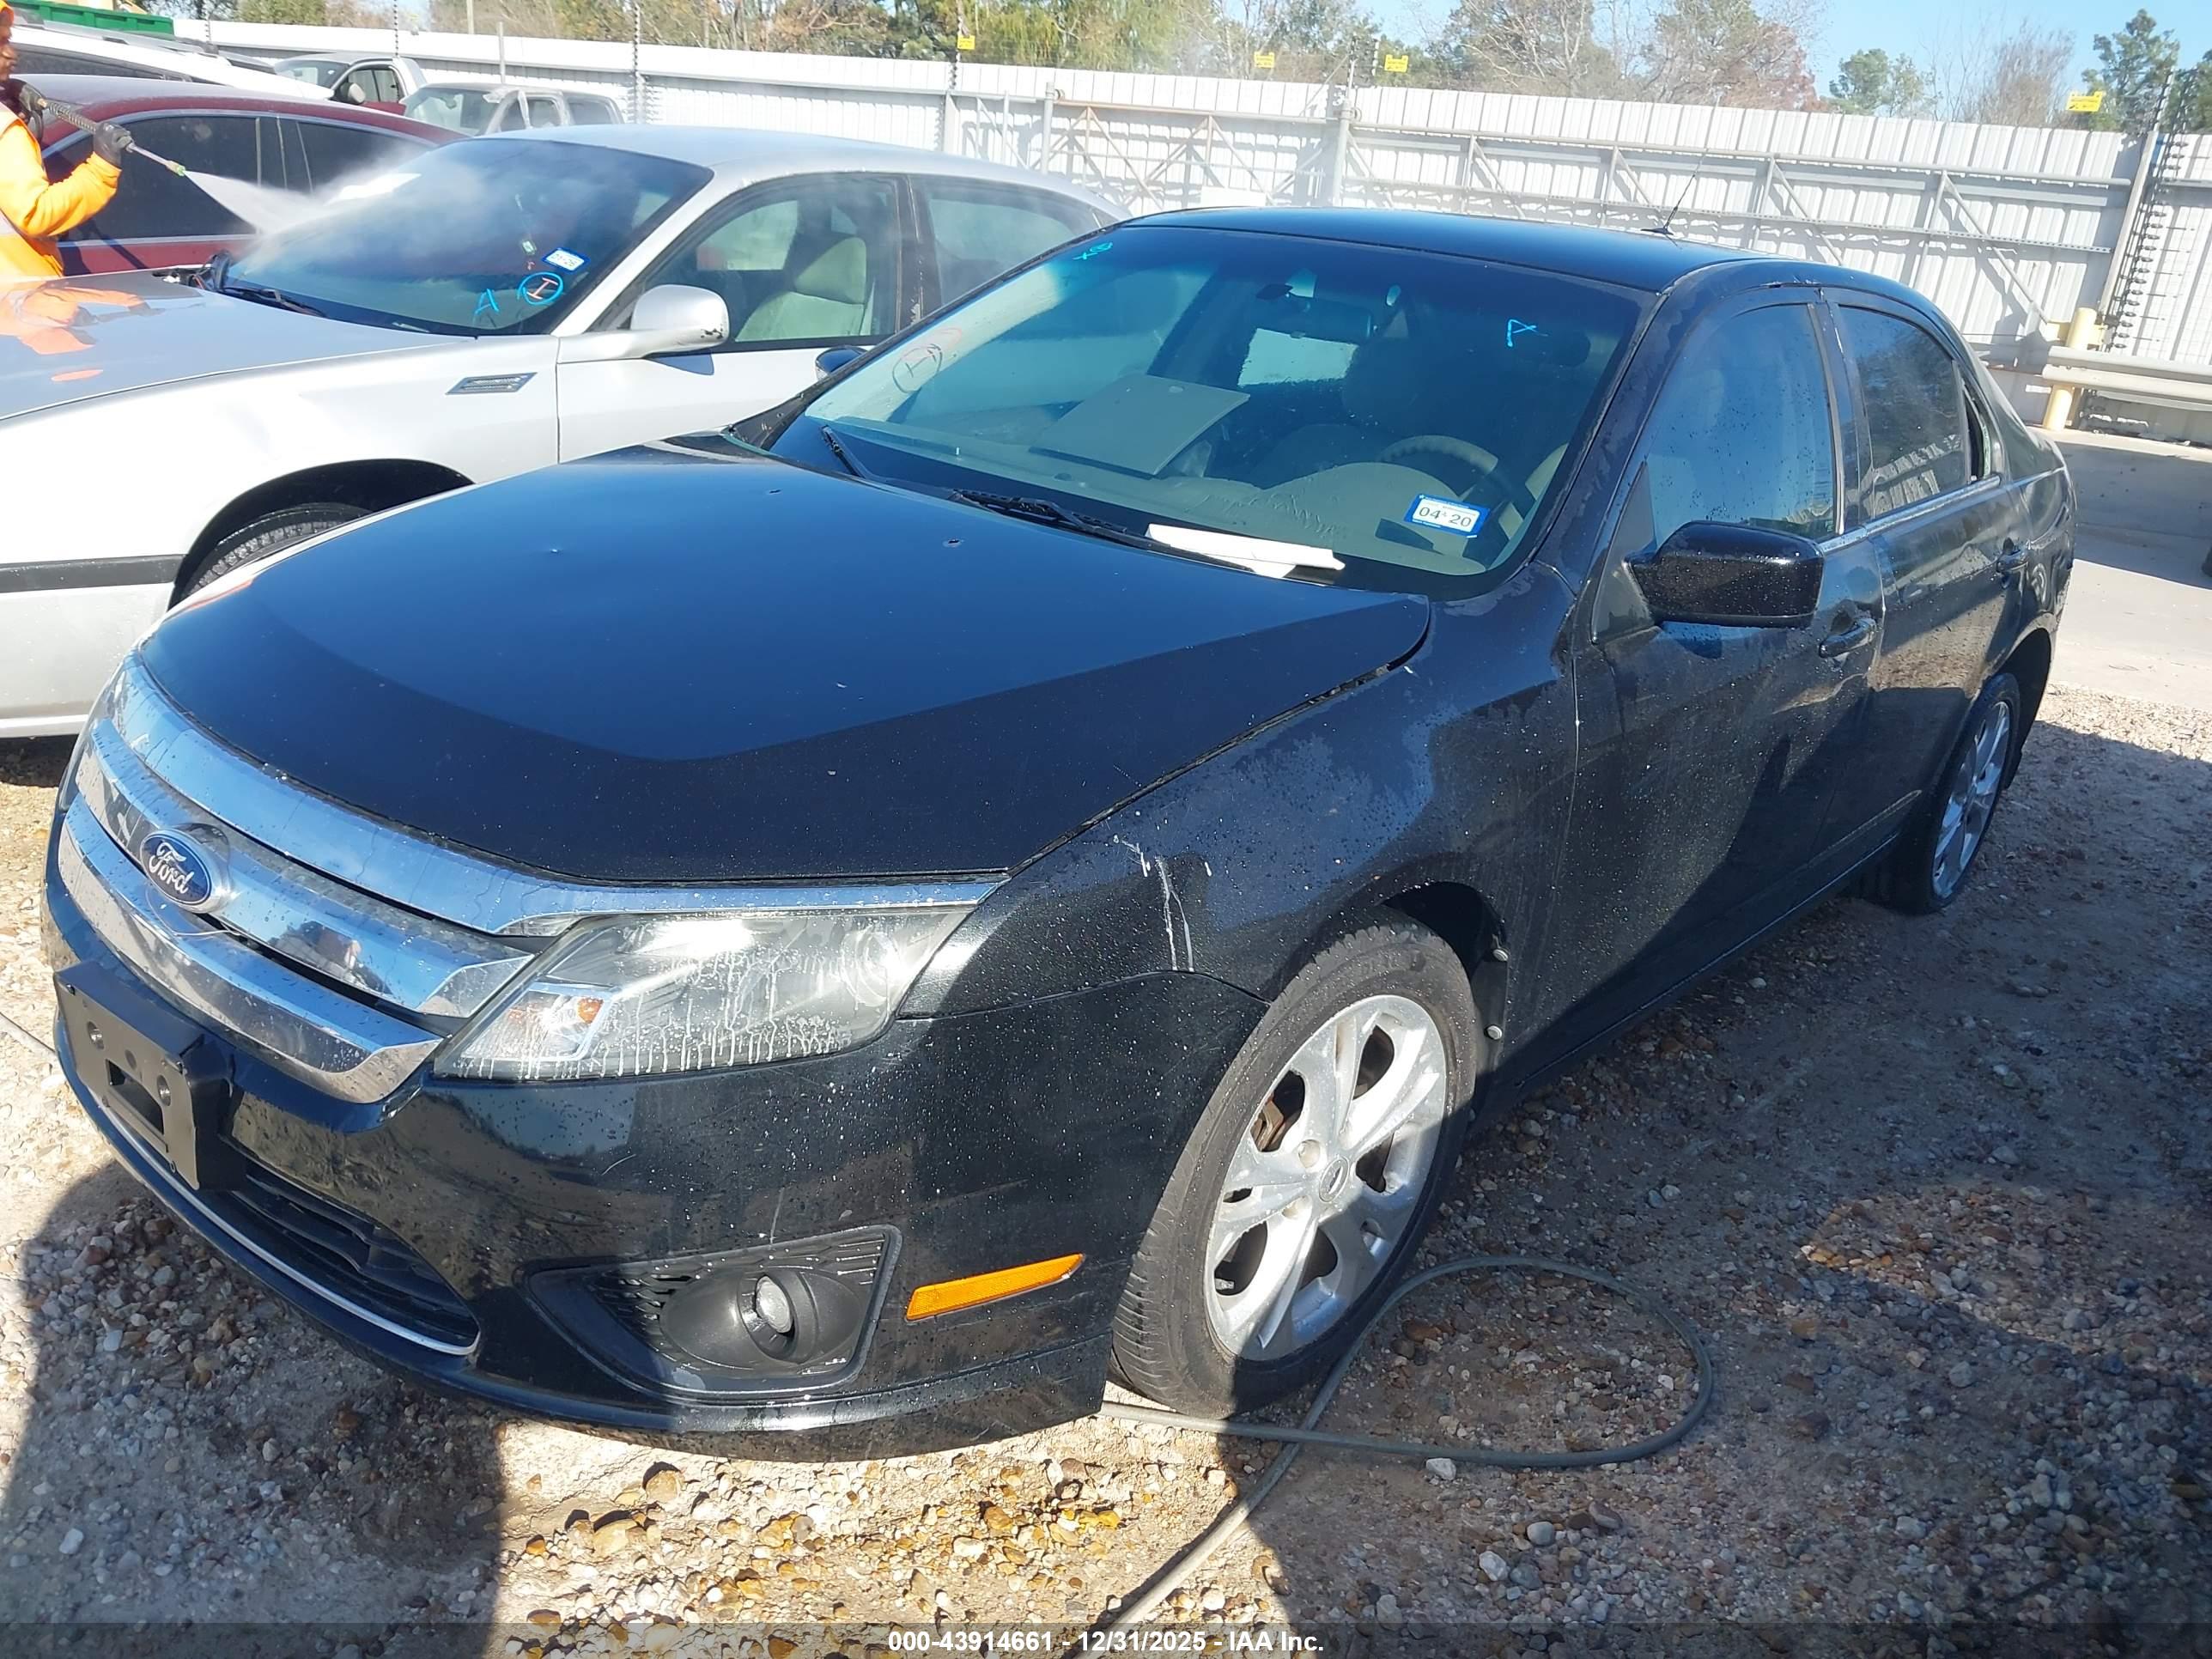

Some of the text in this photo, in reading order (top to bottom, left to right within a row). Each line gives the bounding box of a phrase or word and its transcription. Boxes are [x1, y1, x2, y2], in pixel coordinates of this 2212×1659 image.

[1419, 507, 1441, 520] 04
[1449, 514, 1472, 527] 20
[149, 842, 195, 894] Ford
